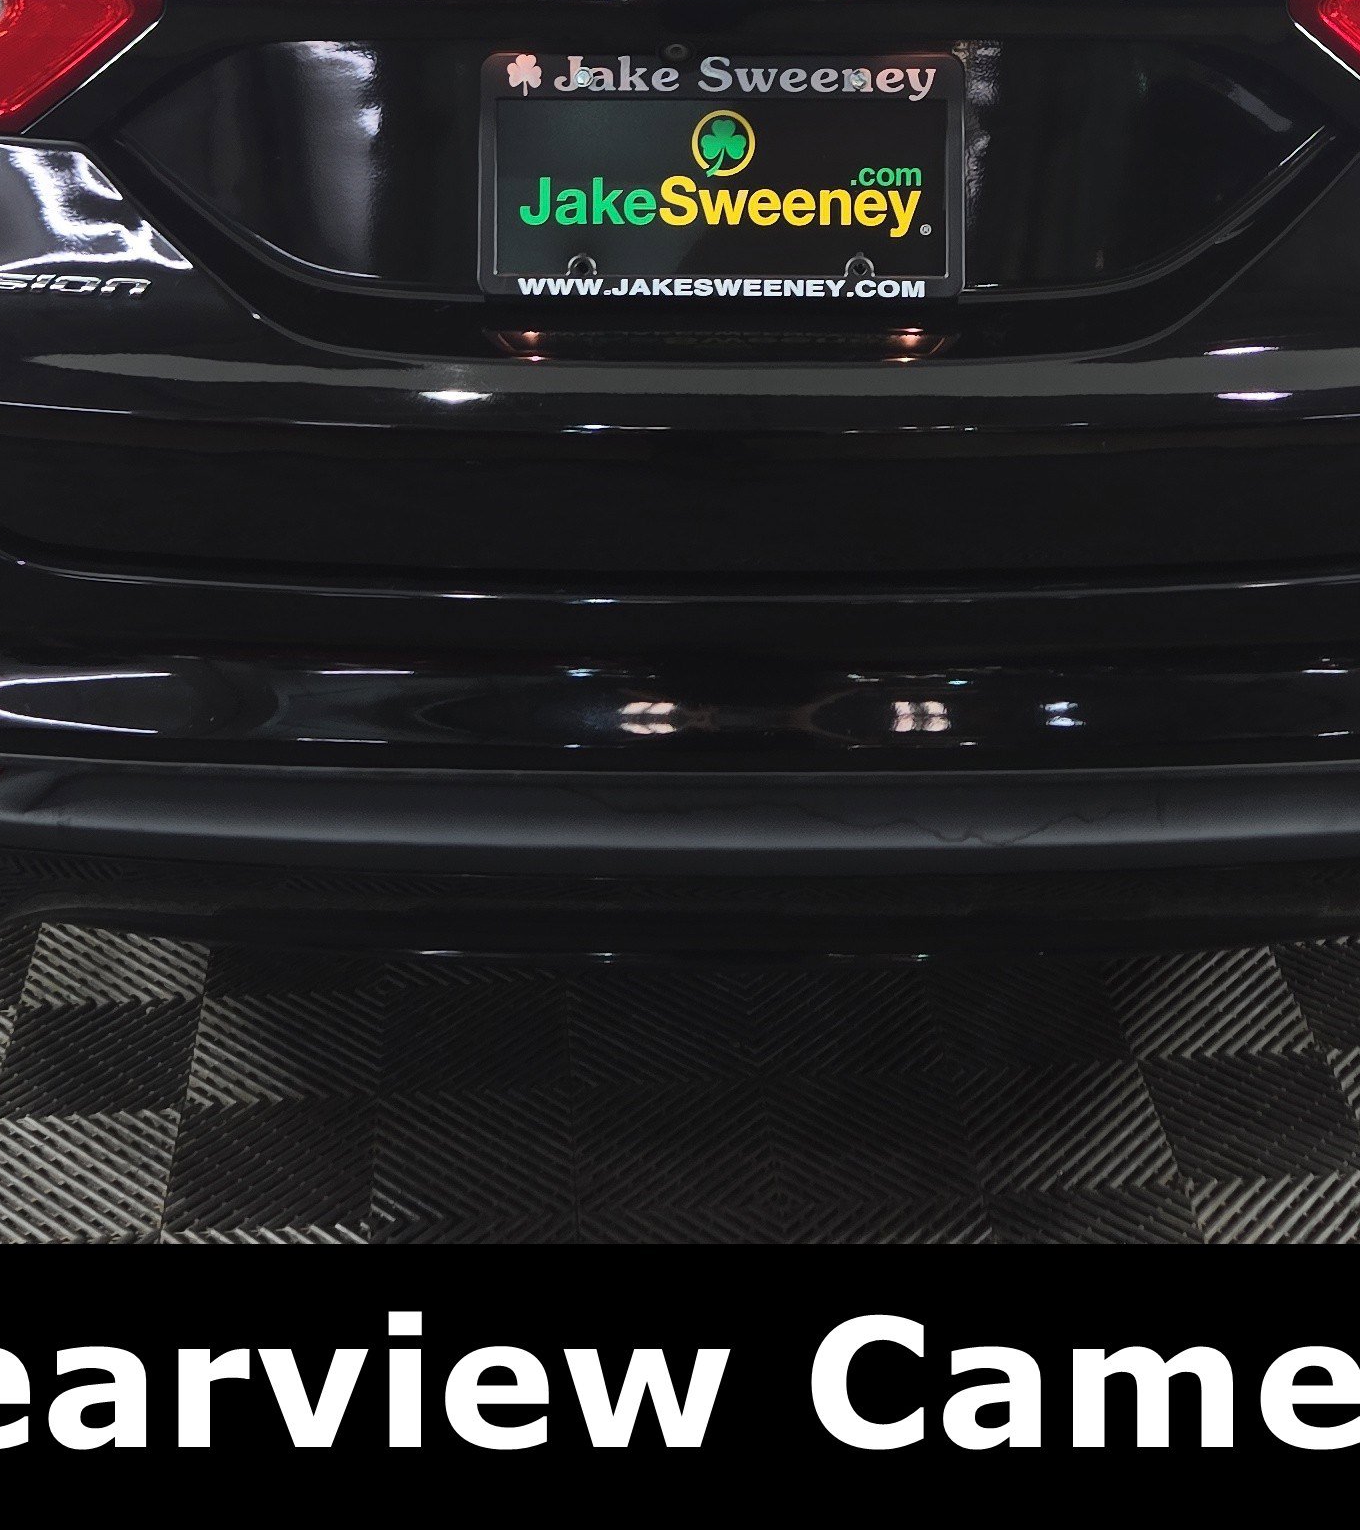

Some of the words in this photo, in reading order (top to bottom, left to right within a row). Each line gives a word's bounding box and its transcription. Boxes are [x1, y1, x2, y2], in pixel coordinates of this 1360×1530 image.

[552, 55, 680, 93] Jake
[697, 55, 938, 102] Sweeney
[850, 167, 922, 187] .com
[517, 277, 927, 299] WWW.JAKESWEENEY.COM
